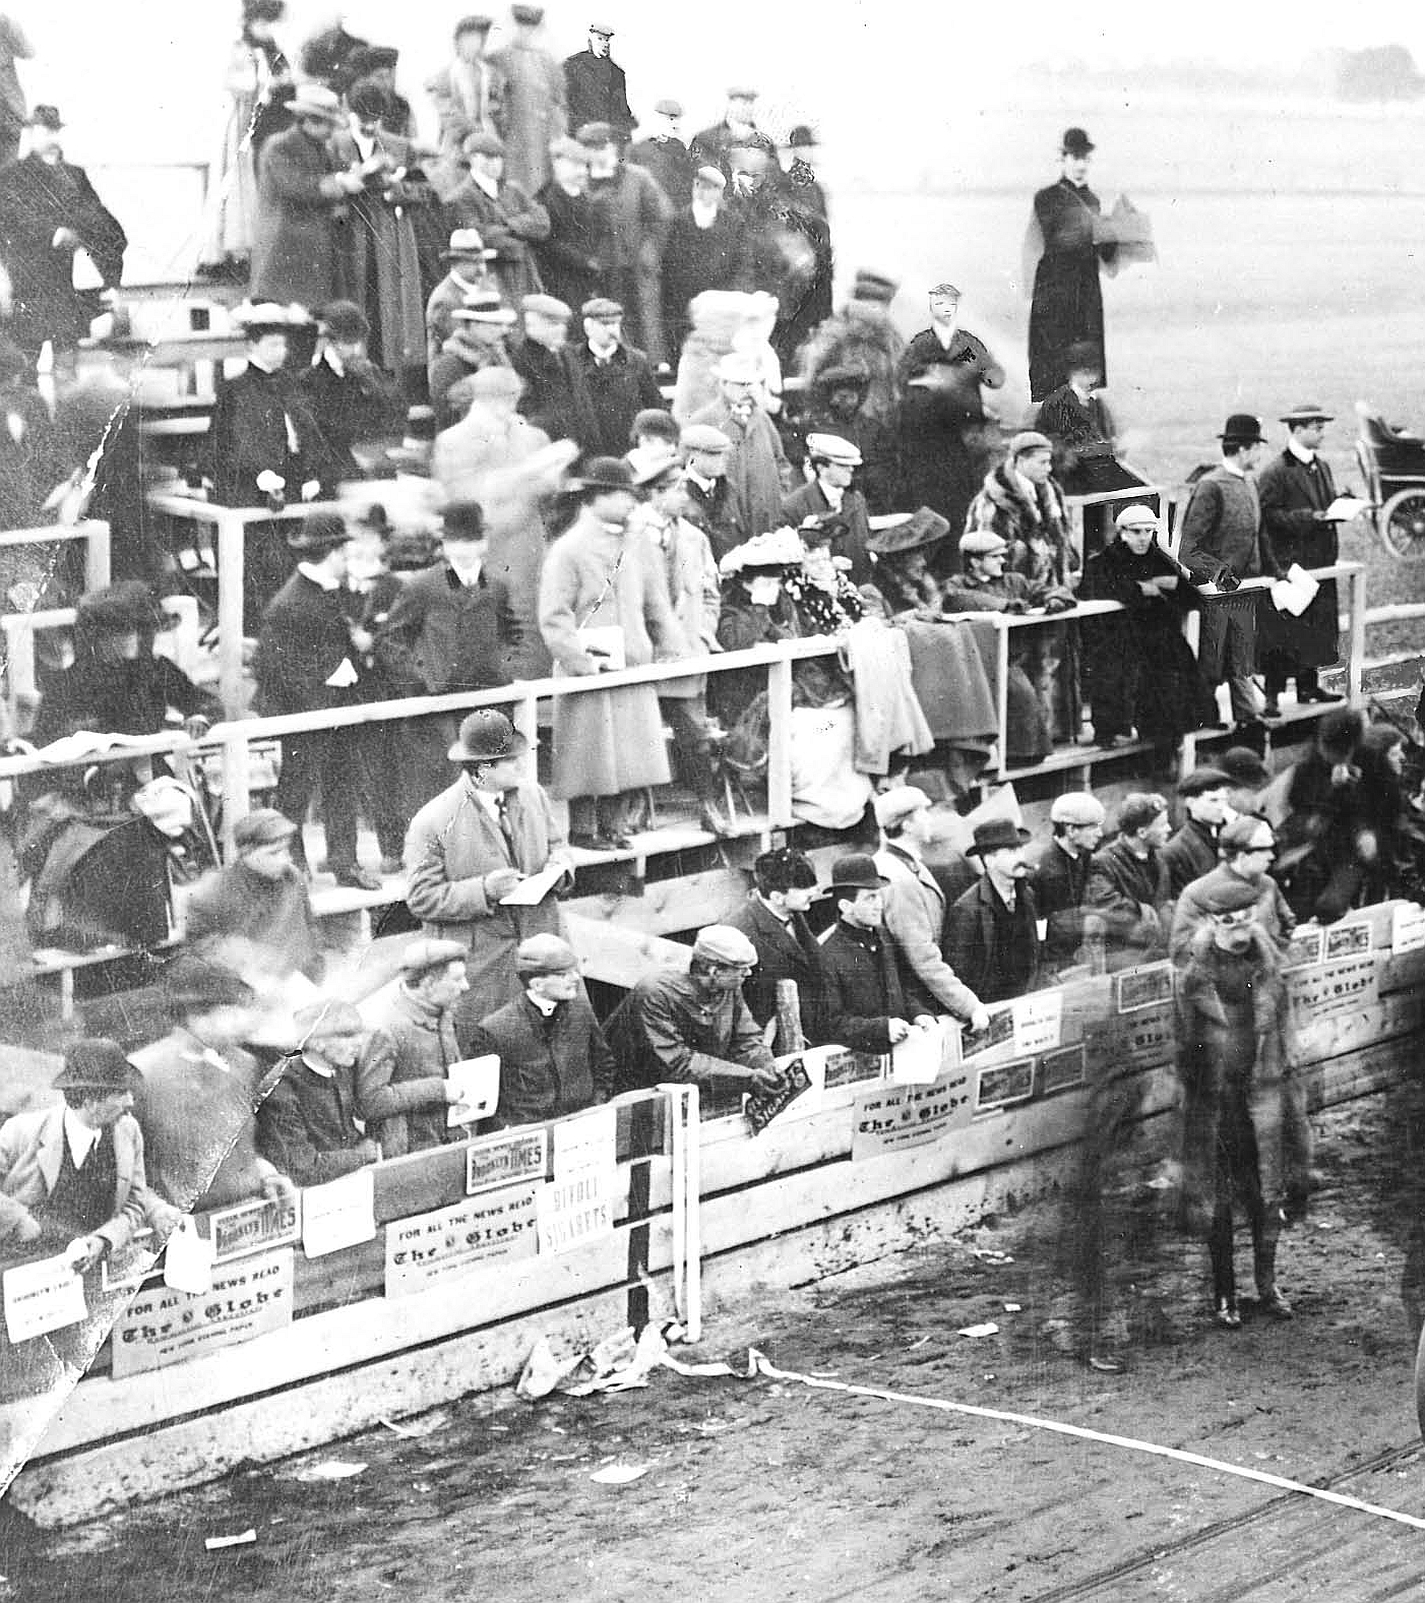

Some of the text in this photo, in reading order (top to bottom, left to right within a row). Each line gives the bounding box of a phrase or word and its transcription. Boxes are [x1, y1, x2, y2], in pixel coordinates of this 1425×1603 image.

[858, 1118, 895, 1133] The
[918, 1095, 969, 1120] Globe
[510, 1146, 542, 1169] TIMES
[394, 1248, 437, 1265] The
[466, 1218, 538, 1244] Globe
[399, 1197, 533, 1241] FOR ALL THE NEWS READ
[127, 1303, 153, 1318] FOR
[160, 1296, 179, 1309] ALL
[212, 1276, 247, 1291] NEWS
[252, 1265, 280, 1281] READ
[123, 1323, 172, 1343] The
[205, 1288, 283, 1318] Globe
